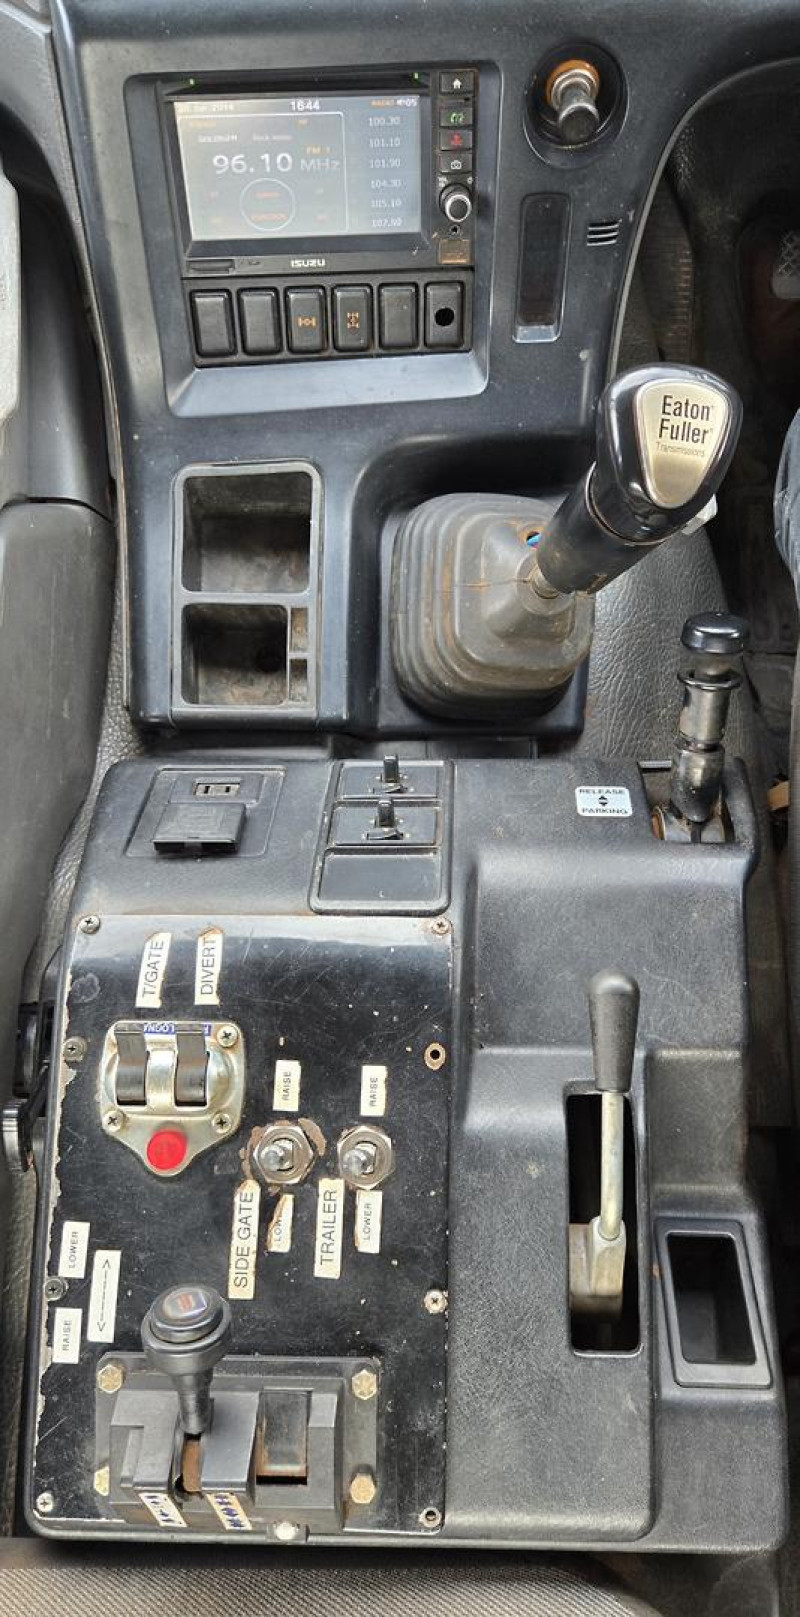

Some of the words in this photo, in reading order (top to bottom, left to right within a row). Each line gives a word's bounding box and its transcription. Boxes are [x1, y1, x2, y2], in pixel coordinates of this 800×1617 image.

[290, 99, 320, 111] 1644
[369, 138, 401, 148] 101.10
[212, 152, 293, 175] 96.10
[300, 158, 341, 171] MHz
[291, 259, 326, 268] ISUZU
[661, 395, 711, 421] Eaton
[658, 418, 710, 444] Fuller
[582, 807, 629, 815] PARKING
[142, 940, 165, 998] T/GATE
[200, 937, 217, 995] DIVERT
[282, 1071, 292, 1101] RAISE
[369, 1077, 378, 1107] RAISE
[237, 1191, 254, 1241] GATE
[320, 1189, 337, 1266] TRAILER
[362, 1203, 372, 1241] LOWER
[68, 1231, 79, 1269] LOWER
[234, 1246, 250, 1288] SIDE
[62, 1319, 73, 1351] RAISE
